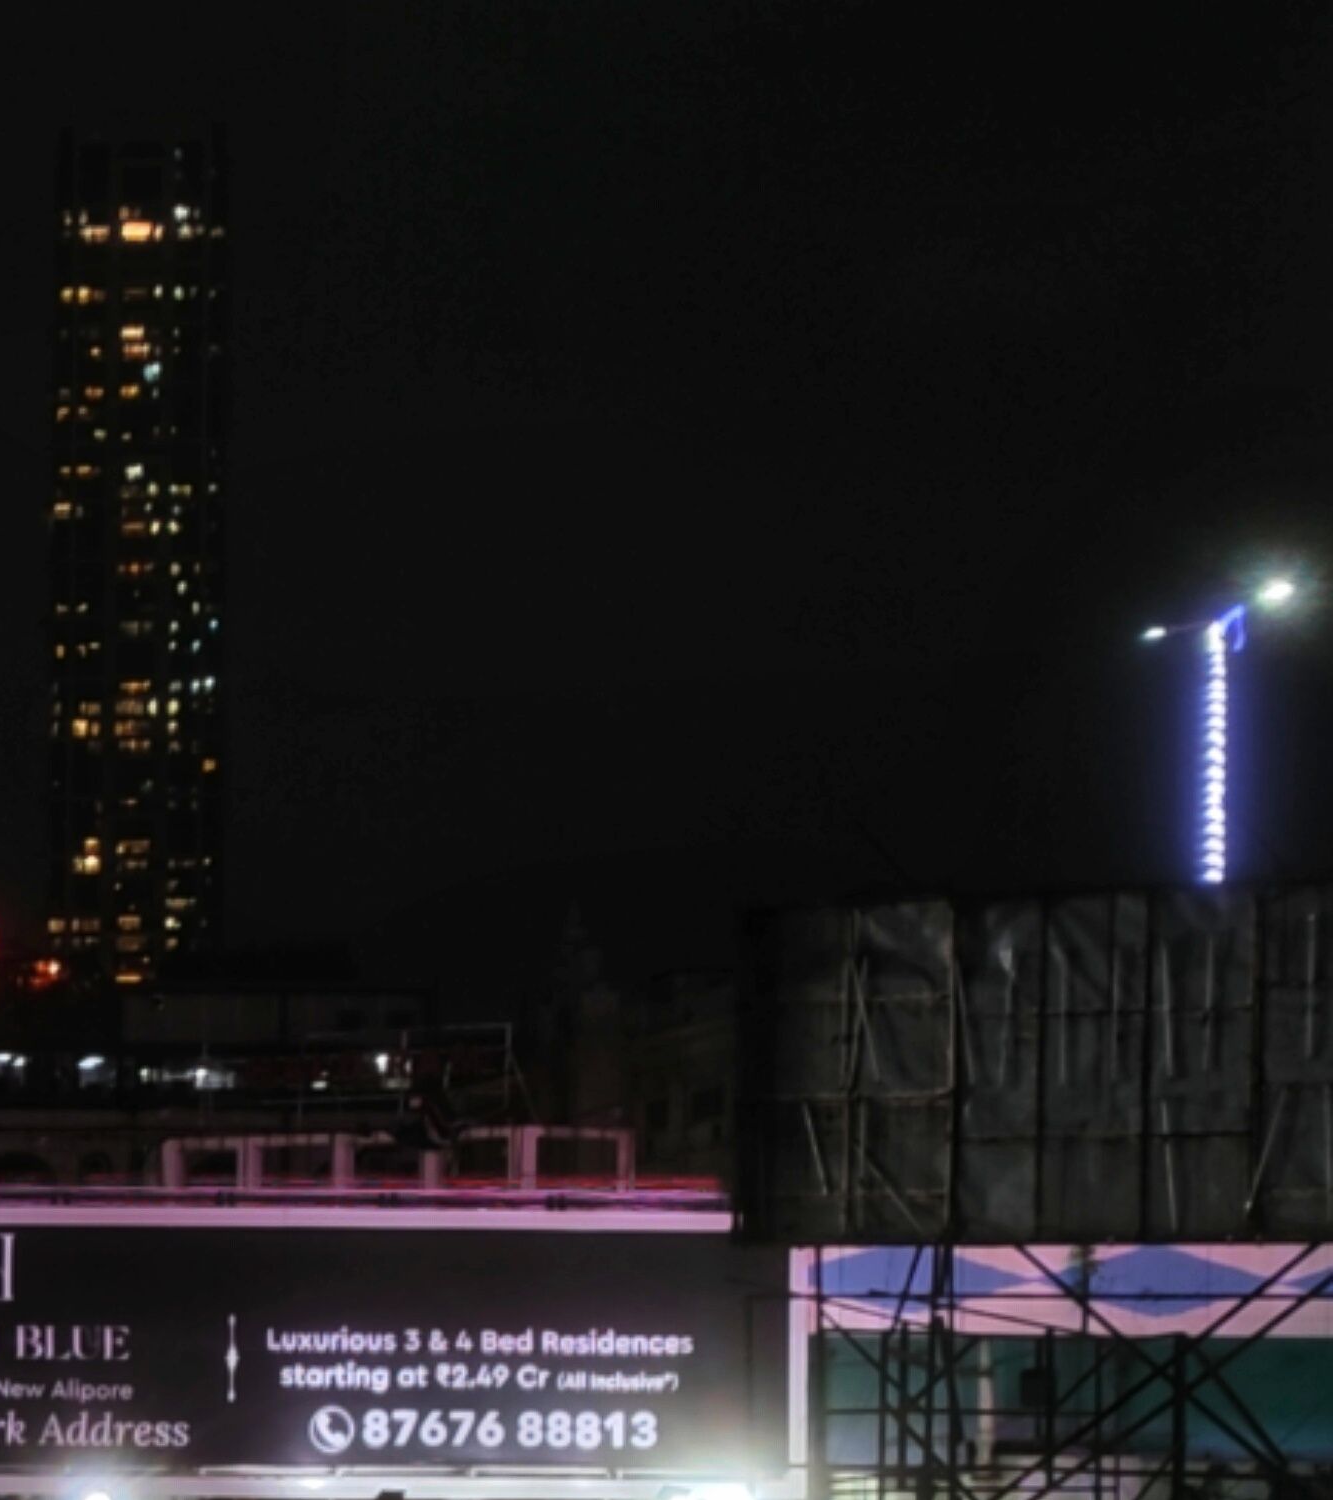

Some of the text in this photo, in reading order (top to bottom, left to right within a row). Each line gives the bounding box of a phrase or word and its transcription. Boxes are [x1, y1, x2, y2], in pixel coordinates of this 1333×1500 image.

[15, 1324, 131, 1361] BLUE
[265, 1326, 695, 1356] Luxurious 3 & 4 Bed Residences
[50, 1378, 134, 1404] Alipore
[279, 1361, 389, 1393] starting
[396, 1364, 429, 1389] at
[516, 1364, 550, 1390] Cr
[38, 1411, 191, 1448] Address
[362, 1409, 659, 1449] 87676 88813
